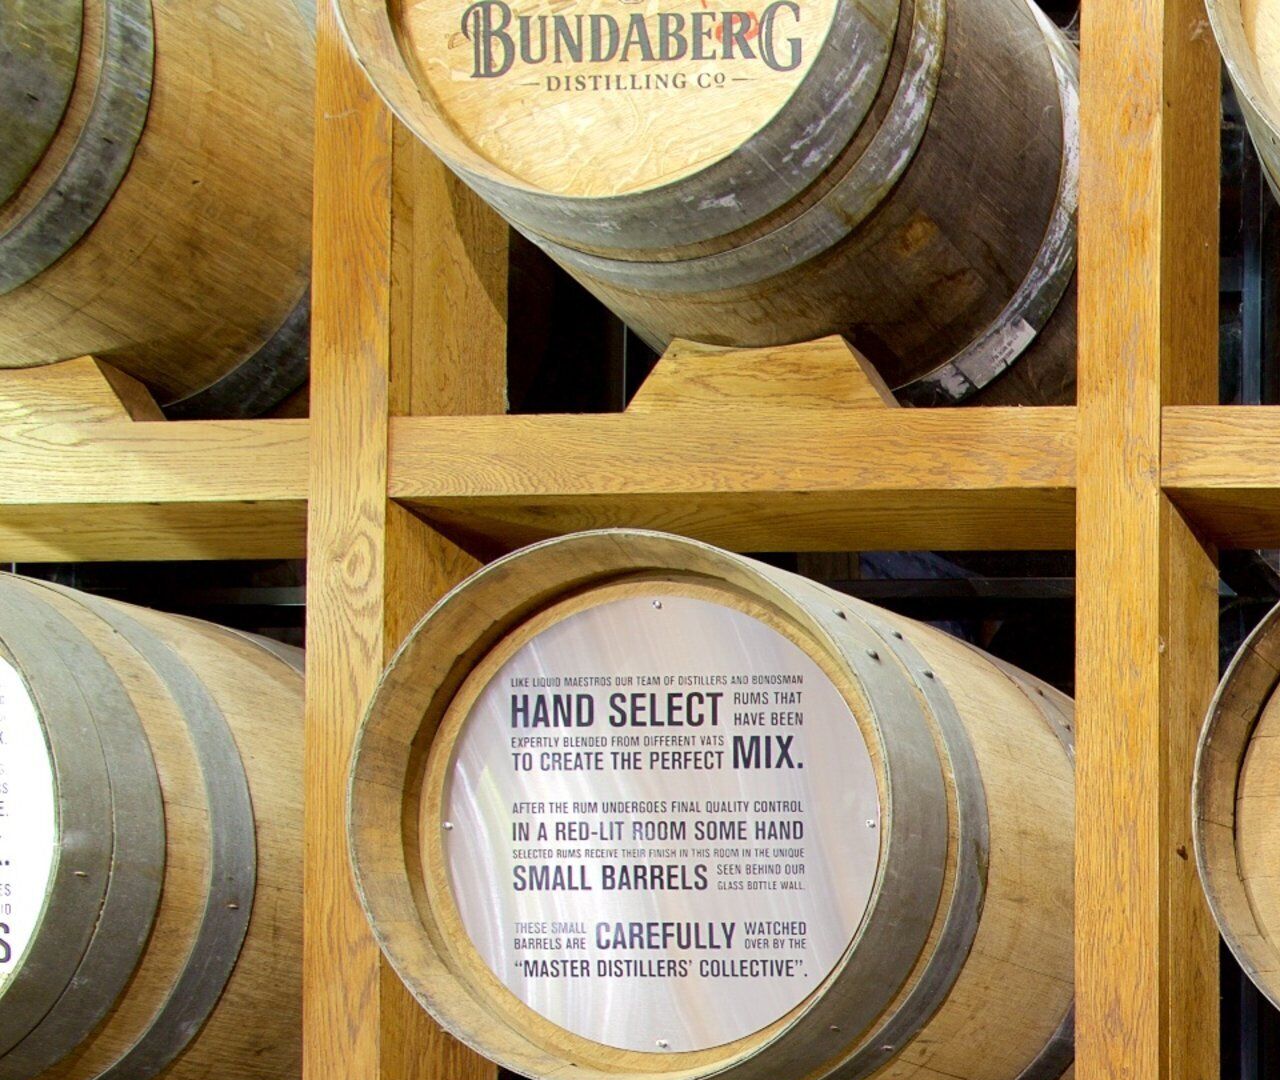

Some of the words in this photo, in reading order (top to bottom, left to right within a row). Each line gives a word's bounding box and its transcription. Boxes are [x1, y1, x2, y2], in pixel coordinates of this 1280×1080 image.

[460, 0, 802, 79] BUNDABERG
[546, 73, 687, 92] DISTILLING
[510, 676, 529, 687] LIKE
[533, 676, 561, 687] LIQUID
[564, 676, 612, 687] MAESTROS
[615, 675, 633, 686] OUR
[636, 675, 660, 686] TEAM
[663, 675, 675, 686] OF
[678, 675, 727, 685] DISTILLERS
[730, 675, 749, 685] AND
[733, 691, 769, 705] RUMS
[774, 691, 803, 705] THAT
[511, 693, 594, 728] HAND
[609, 691, 723, 727] SELECT
[733, 712, 765, 726] HAVE
[771, 712, 804, 726] BEEN
[511, 736, 559, 748] EXPERTLY
[563, 736, 607, 748] BLENDED
[611, 736, 639, 748] FROM
[643, 736, 695, 747] DIFFERENT
[700, 735, 724, 746] VATS
[732, 735, 804, 769] MIX.
[512, 752, 533, 771] TO
[540, 752, 604, 771] CREATE
[611, 751, 642, 770] THE
[650, 751, 724, 770] PERFECT
[512, 802, 545, 814] AFTER
[549, 802, 568, 814] THE
[573, 802, 597, 814] RUM
[602, 801, 667, 813] UNDERGOES
[671, 801, 700, 813] FINAL
[706, 801, 749, 813] QUALITY
[754, 800, 804, 812] CONTROL
[512, 822, 530, 841] IN
[537, 822, 548, 841] A
[555, 821, 624, 841] RED-LIT
[632, 821, 686, 841] ROOM
[694, 820, 747, 840] SOME
[755, 820, 804, 840] HAND
[512, 849, 553, 859] SELECTED
[556, 849, 582, 859] RUMS
[585, 849, 618, 859] RECEIVE
[621, 849, 646, 859] THEIR
[649, 849, 676, 859] FINISH
[679, 849, 688, 859] IN
[692, 848, 710, 858] THIS
[713, 848, 739, 858] ROOM
[742, 848, 751, 858] IN
[754, 848, 770, 858] THE
[773, 848, 805, 858] UNIQUE
[716, 864, 741, 875] SEEN
[746, 864, 781, 875] BEHIND
[785, 864, 805, 875] OUR
[512, 865, 592, 891] SMALL
[602, 864, 708, 891] BARRELS
[717, 880, 744, 890] GLASS
[747, 880, 777, 890] BOTTLE
[514, 922, 547, 934] THESE
[551, 922, 587, 934] SMALL
[744, 921, 807, 935] WATCHED
[595, 922, 736, 950] CAREFULLY
[514, 938, 562, 950] BARRELS
[566, 938, 586, 950] ARE
[744, 938, 769, 949] OVER
[772, 938, 786, 949] BY
[789, 938, 807, 949] THE
